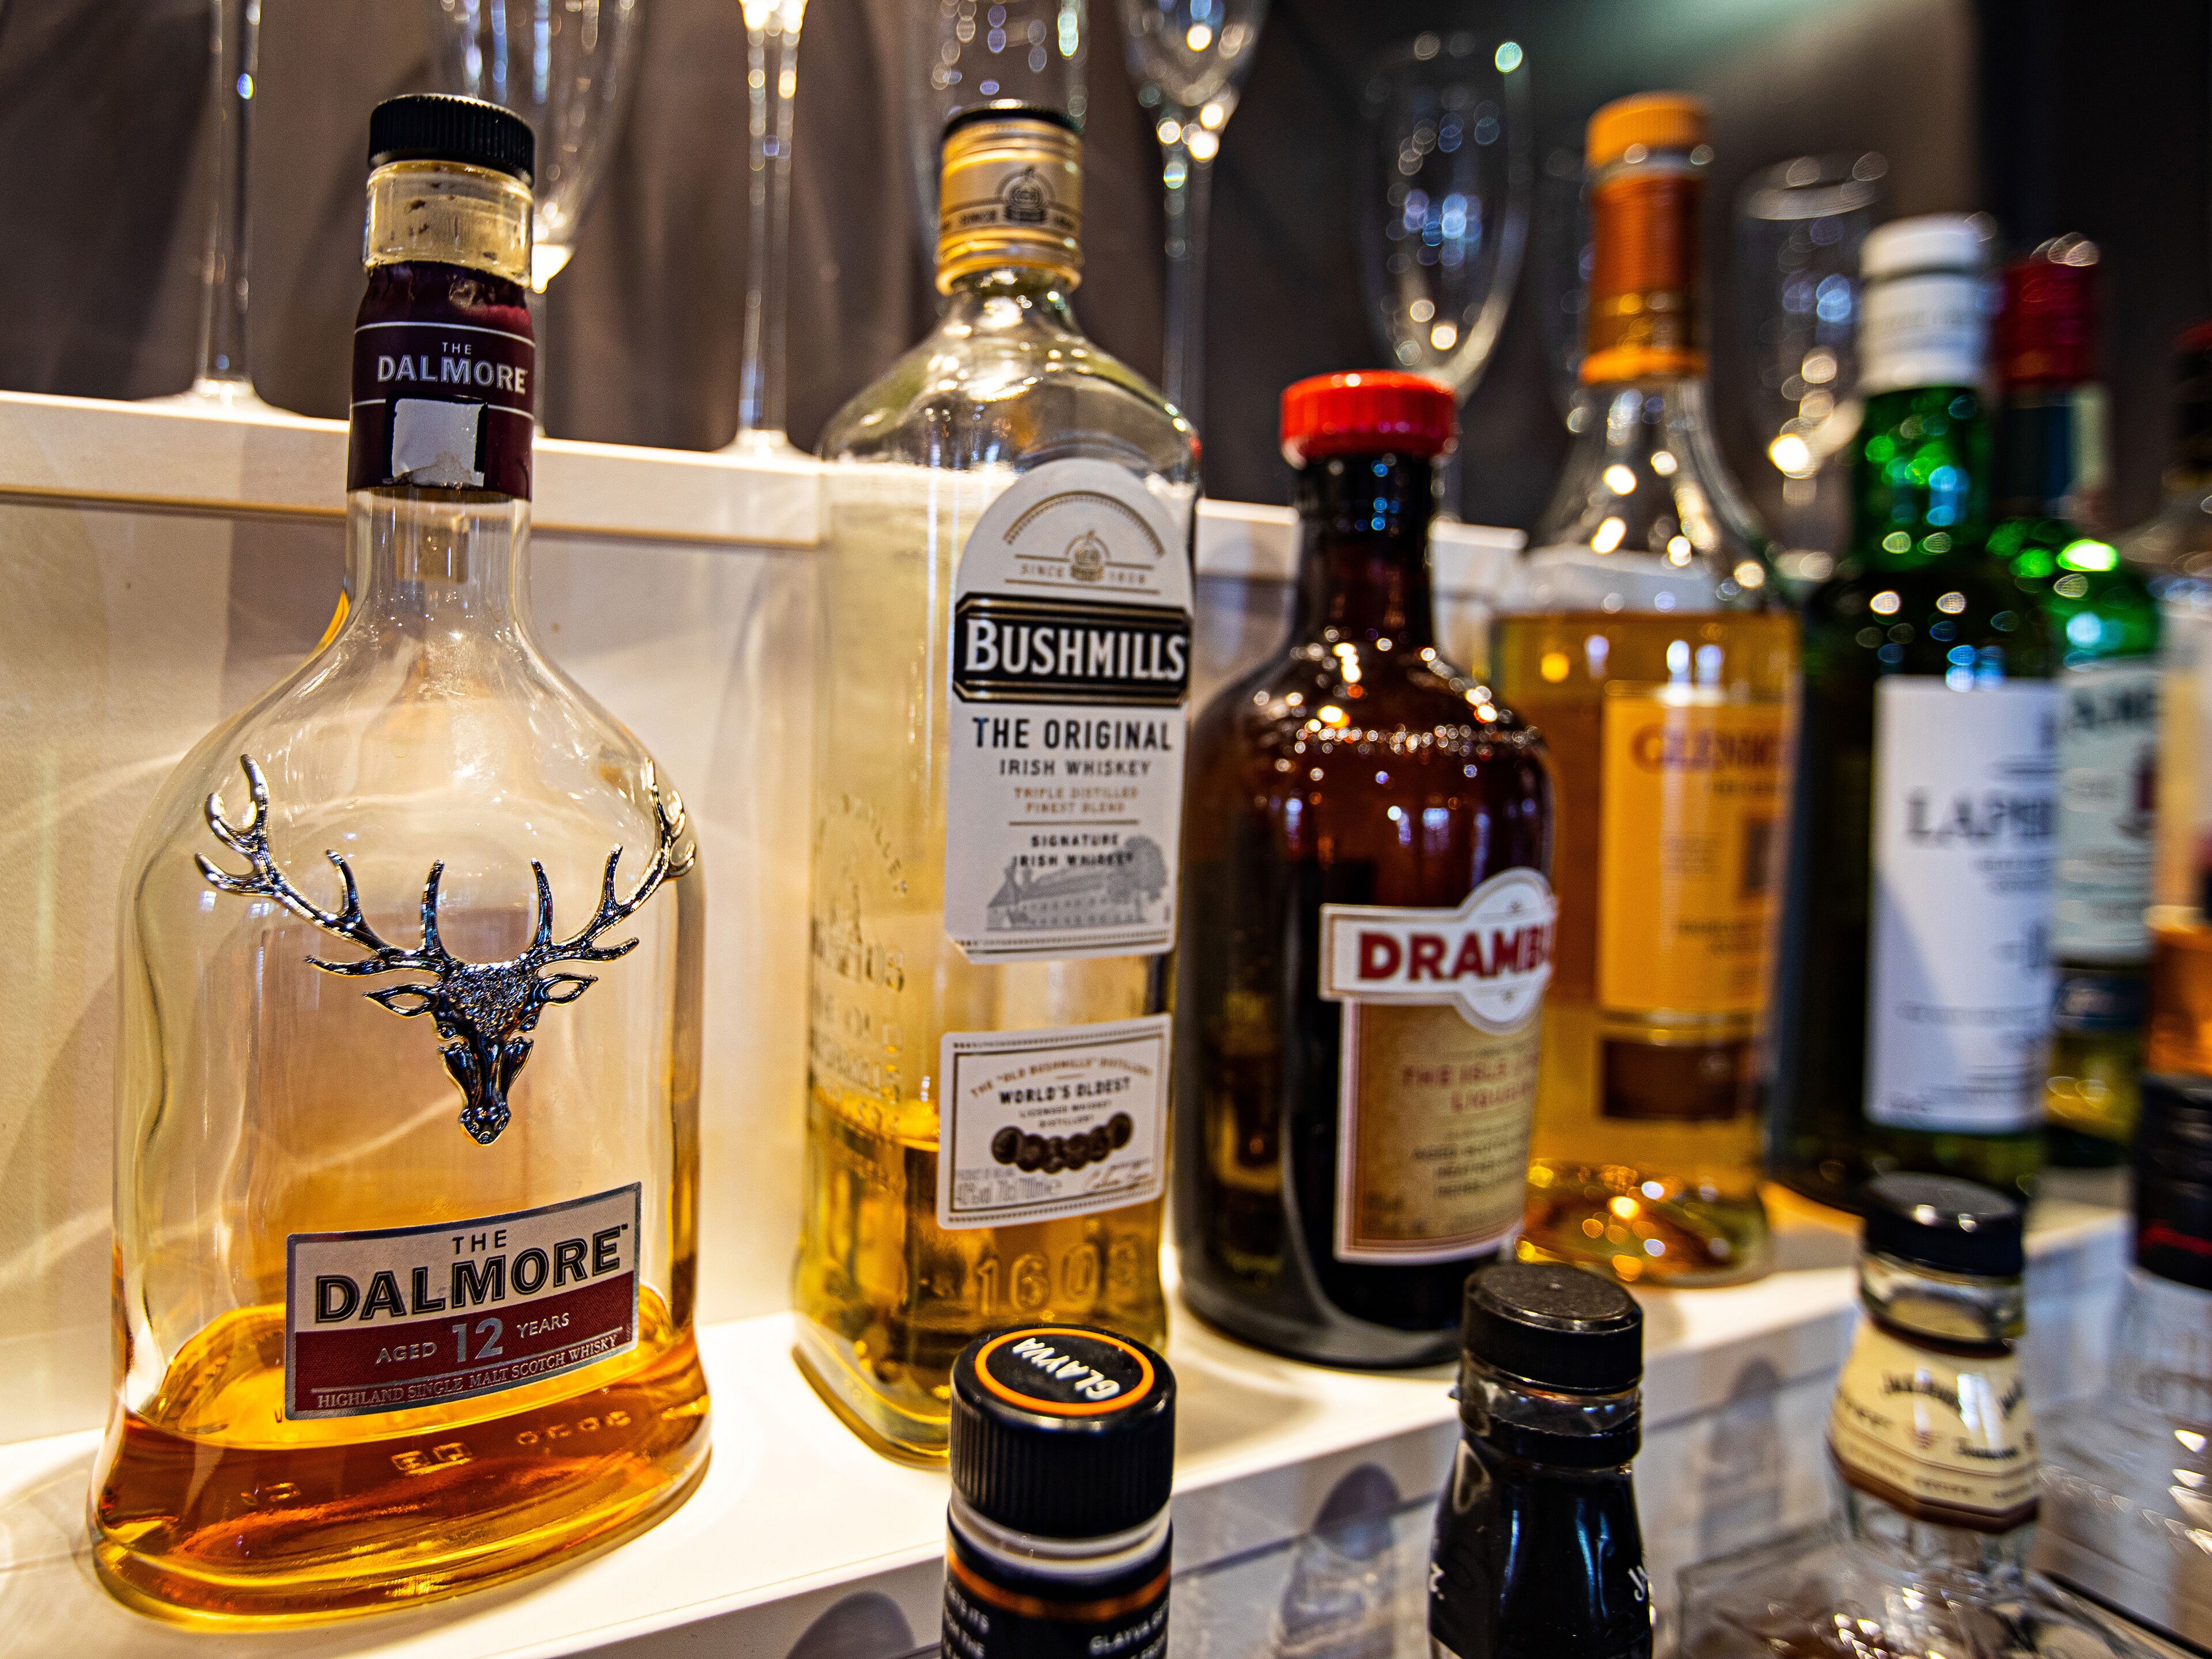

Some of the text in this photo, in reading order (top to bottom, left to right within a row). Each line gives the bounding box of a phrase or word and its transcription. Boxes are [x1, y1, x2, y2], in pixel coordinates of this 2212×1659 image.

[442, 342, 472, 355] THE
[377, 355, 529, 395] DALMORE
[964, 618, 1187, 681] BUSHMILLS
[972, 717, 1173, 751] THE ORIGINAL
[999, 759, 1152, 778] IRISH WHISKEY
[1032, 834, 1118, 848] SIGNATURE
[1012, 854, 1058, 867] IRISH
[998, 1075, 1131, 1104] WORLD'S OLDEST
[452, 1229, 507, 1255] THE
[376, 1313, 570, 1363] AGED 12 YEARS
[317, 1335, 618, 1408] HIGHLAND SINGLE MALT SCOTCH WHISKY
[1012, 1336, 1120, 1400] GLAYVA
